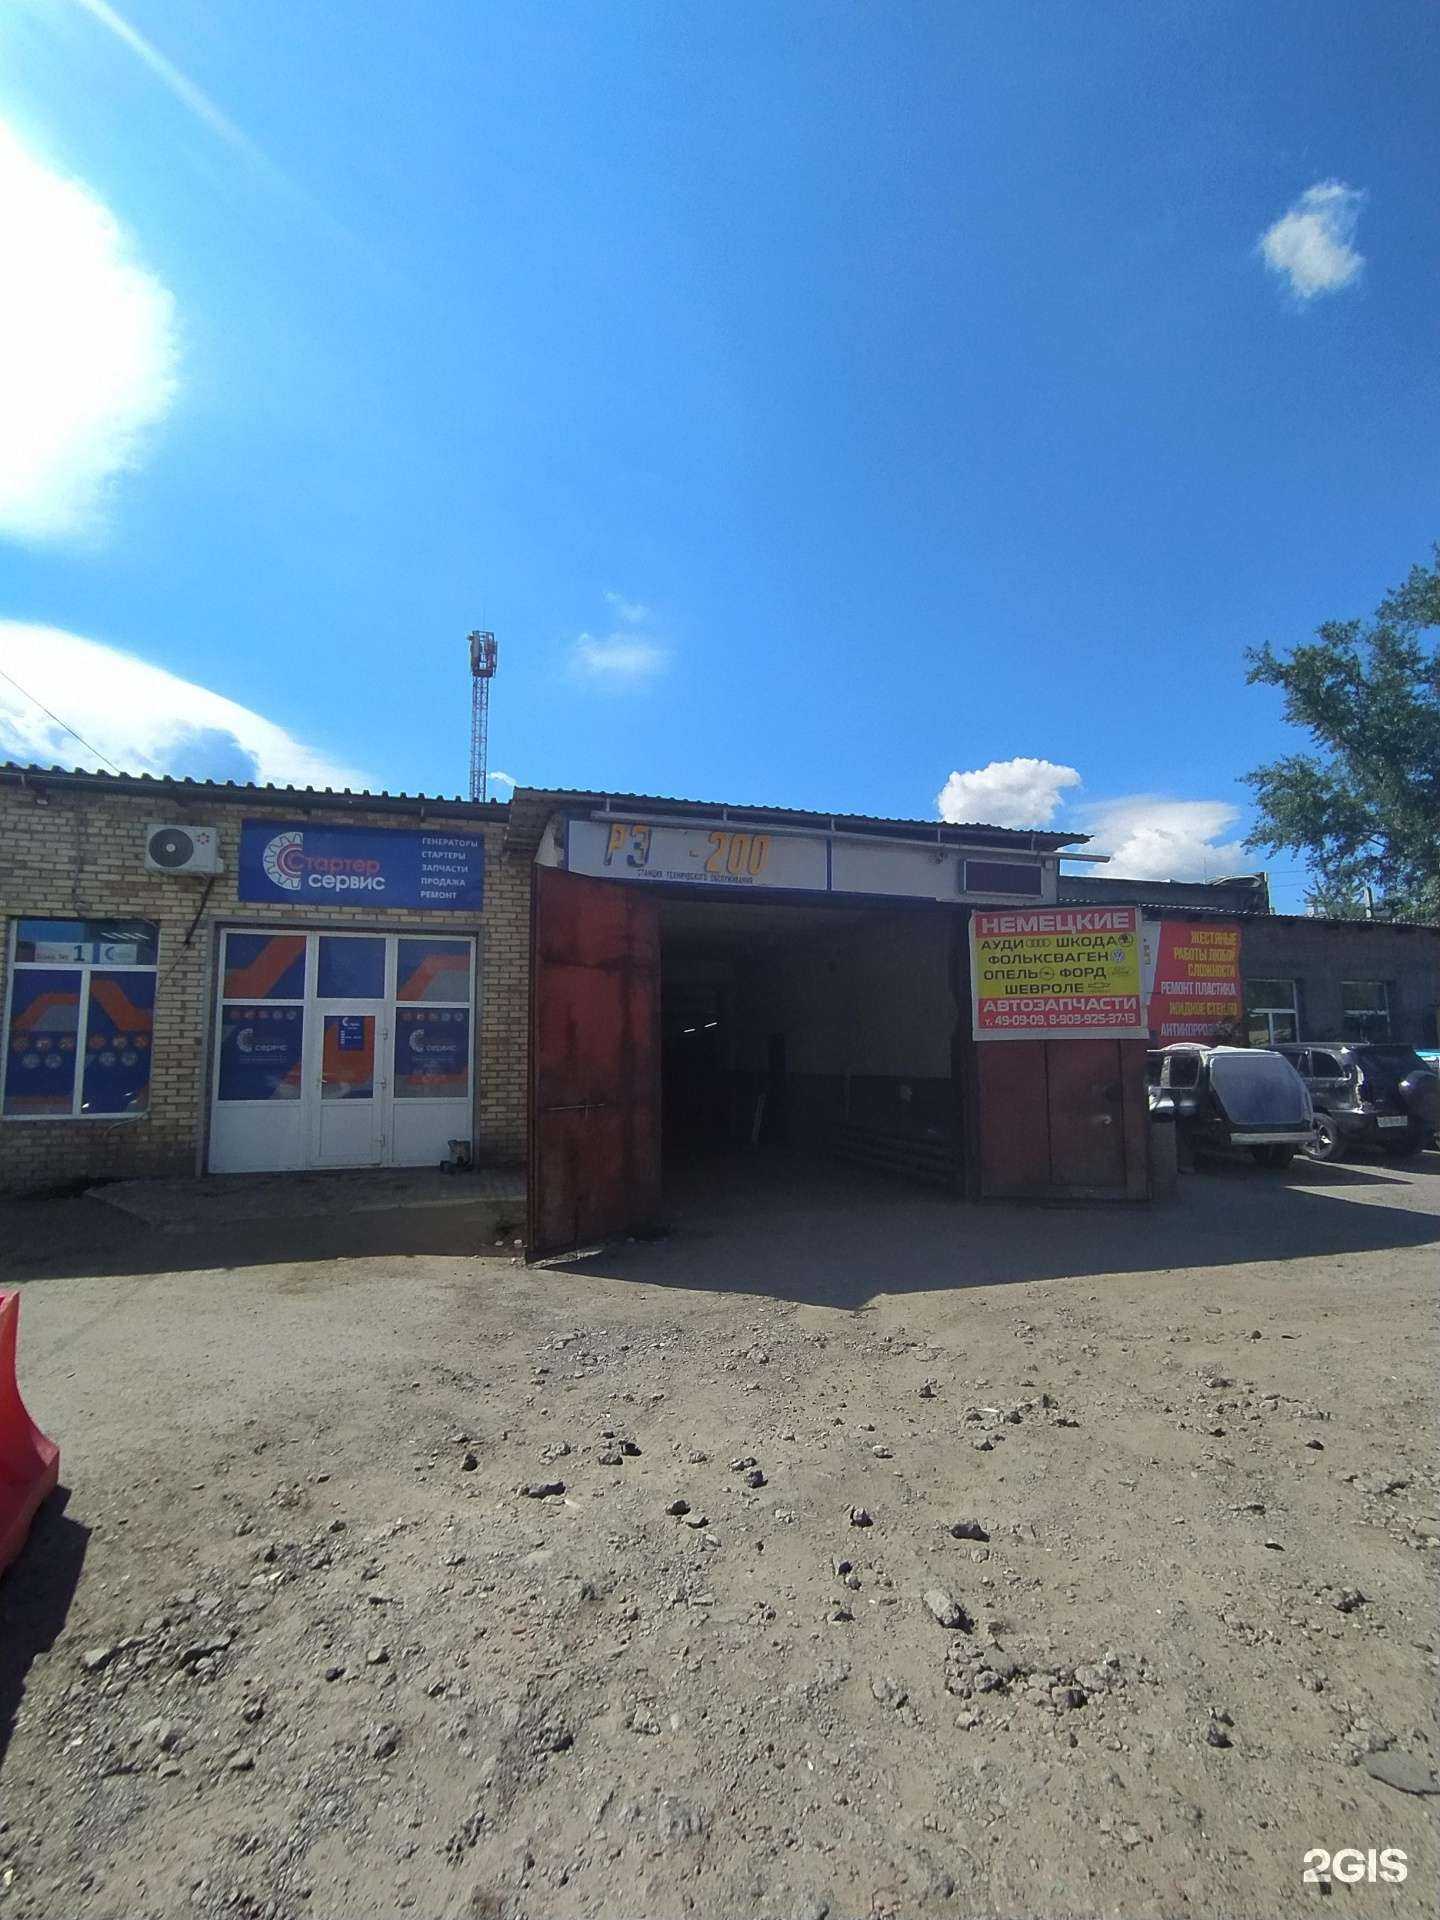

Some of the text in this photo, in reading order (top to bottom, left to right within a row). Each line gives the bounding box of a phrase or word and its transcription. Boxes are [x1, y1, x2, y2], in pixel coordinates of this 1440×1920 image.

[422, 837, 478, 848] ГЕНЕРАТОРЫ
[422, 851, 466, 860] СТАРТЕРЫ
[287, 852, 380, 876] Стартер
[422, 864, 469, 873] ЗАПЧАСТИ
[308, 874, 385, 892] сервис
[421, 877, 466, 887] ПРОДАЖА
[420, 890, 457, 900] РЕМОНТ
[982, 912, 1129, 934] НЕМЕЦКИЕ
[981, 935, 1118, 952] АУДИ ШКОДА
[988, 951, 1109, 965] ФОЛЬКСВАГЕН
[984, 967, 1106, 981] ОПЕЛЬ ФОРД
[1005, 983, 1084, 995] ШЕВРОЛЕ
[1161, 981, 1236, 996] РЕМОНТ ПЛАСТИКА
[983, 997, 1137, 1012] АВТОЗАПЧАСТИ
